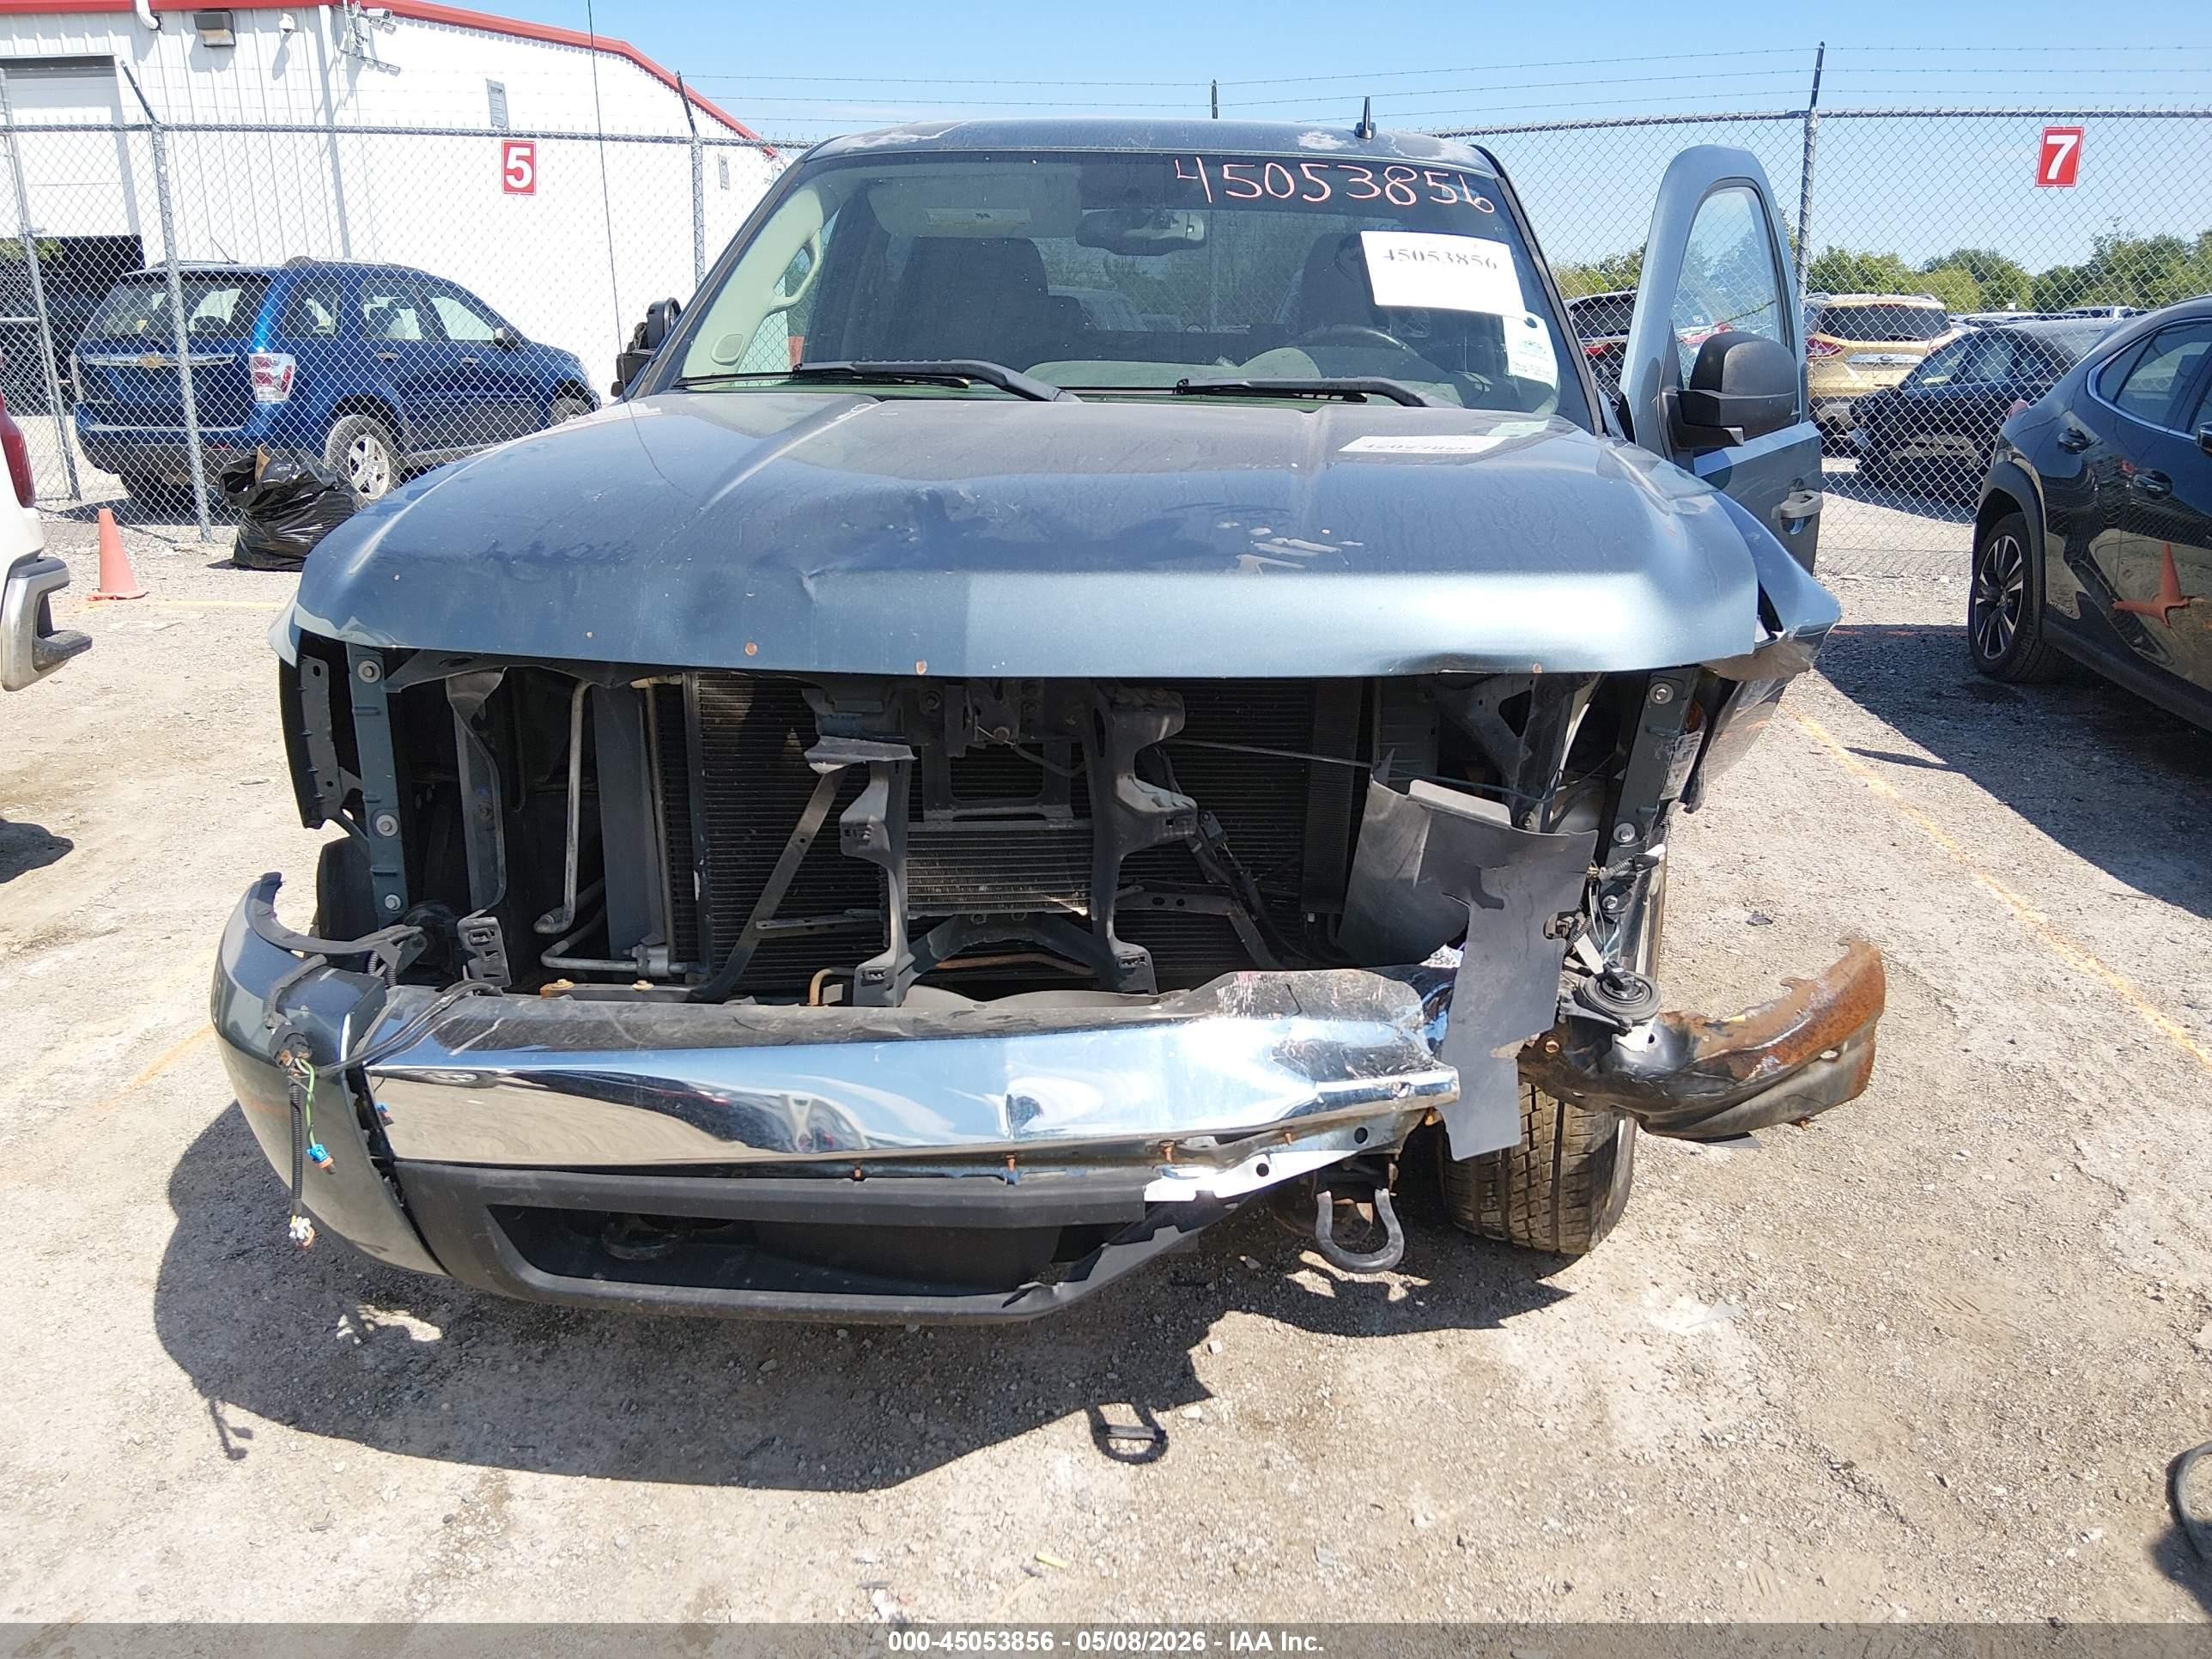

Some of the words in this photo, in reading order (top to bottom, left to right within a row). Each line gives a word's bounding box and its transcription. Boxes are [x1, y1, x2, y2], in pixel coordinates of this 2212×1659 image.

[505, 146, 532, 189] 5
[2045, 134, 2078, 180] 7
[1175, 156, 1495, 214] 45053856
